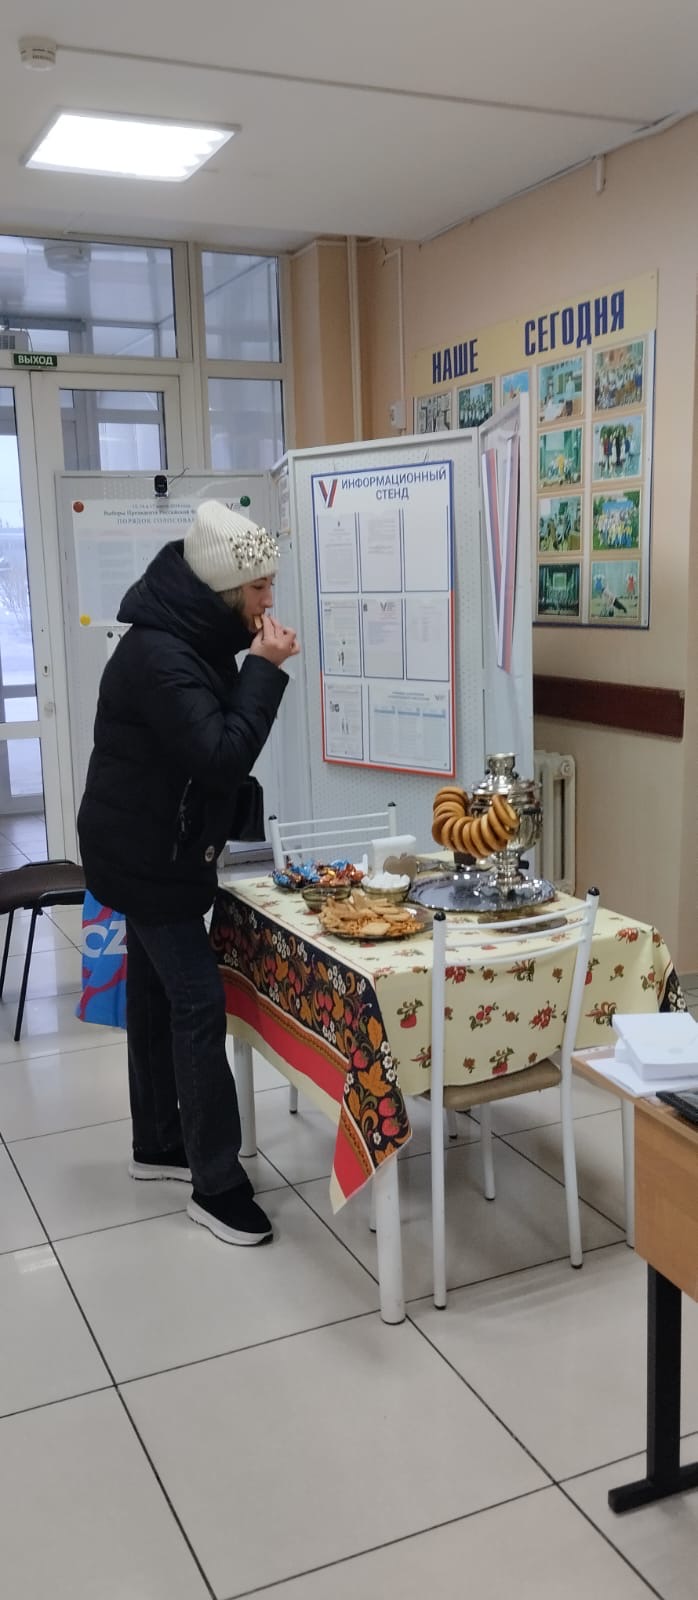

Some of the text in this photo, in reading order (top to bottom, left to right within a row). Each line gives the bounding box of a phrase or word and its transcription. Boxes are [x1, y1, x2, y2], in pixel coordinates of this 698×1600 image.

[432, 289, 625, 384] НАШЕ СЕГОДНЯ
[18, 355, 53, 365] ВЫХОД
[341, 466, 447, 489] ИНФОРМАЦИОННЫЙ
[376, 487, 410, 500] СТЕНД
